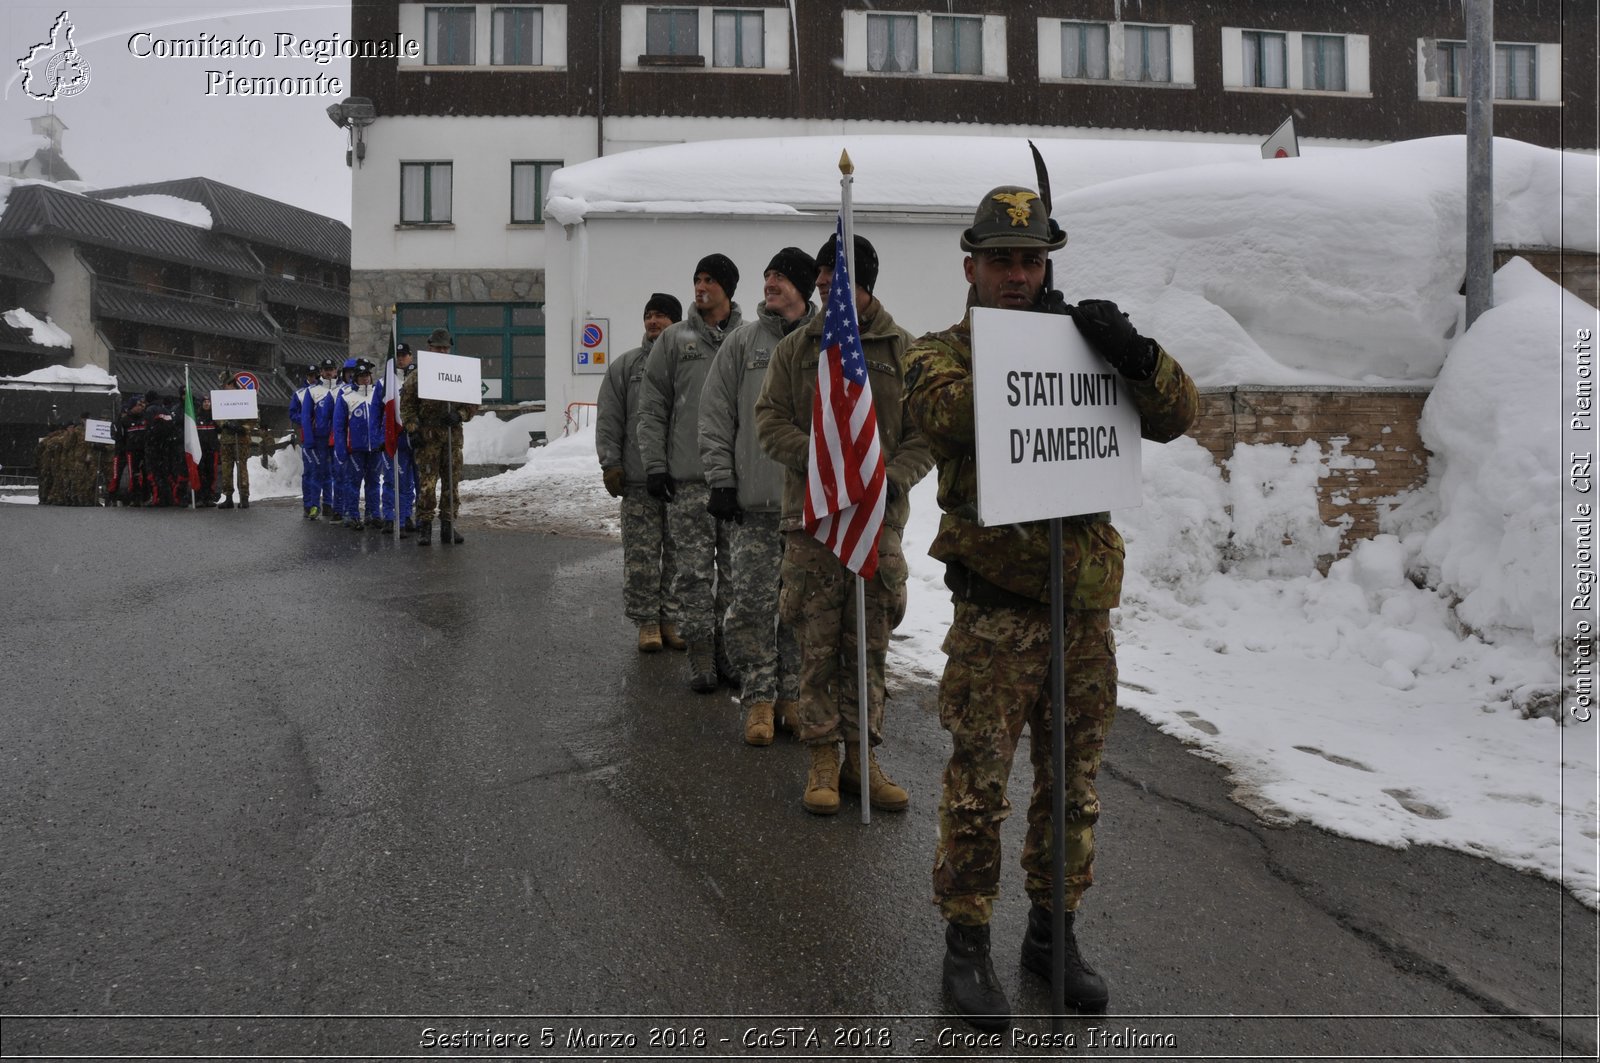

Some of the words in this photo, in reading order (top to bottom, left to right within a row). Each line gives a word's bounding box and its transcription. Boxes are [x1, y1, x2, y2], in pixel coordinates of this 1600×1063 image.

[579, 353, 586, 363] P
[438, 372, 463, 383] ITALIA
[1006, 370, 1064, 407] STATI
[1070, 372, 1118, 406] UNITI
[1009, 425, 1120, 464] D'AMERICA
